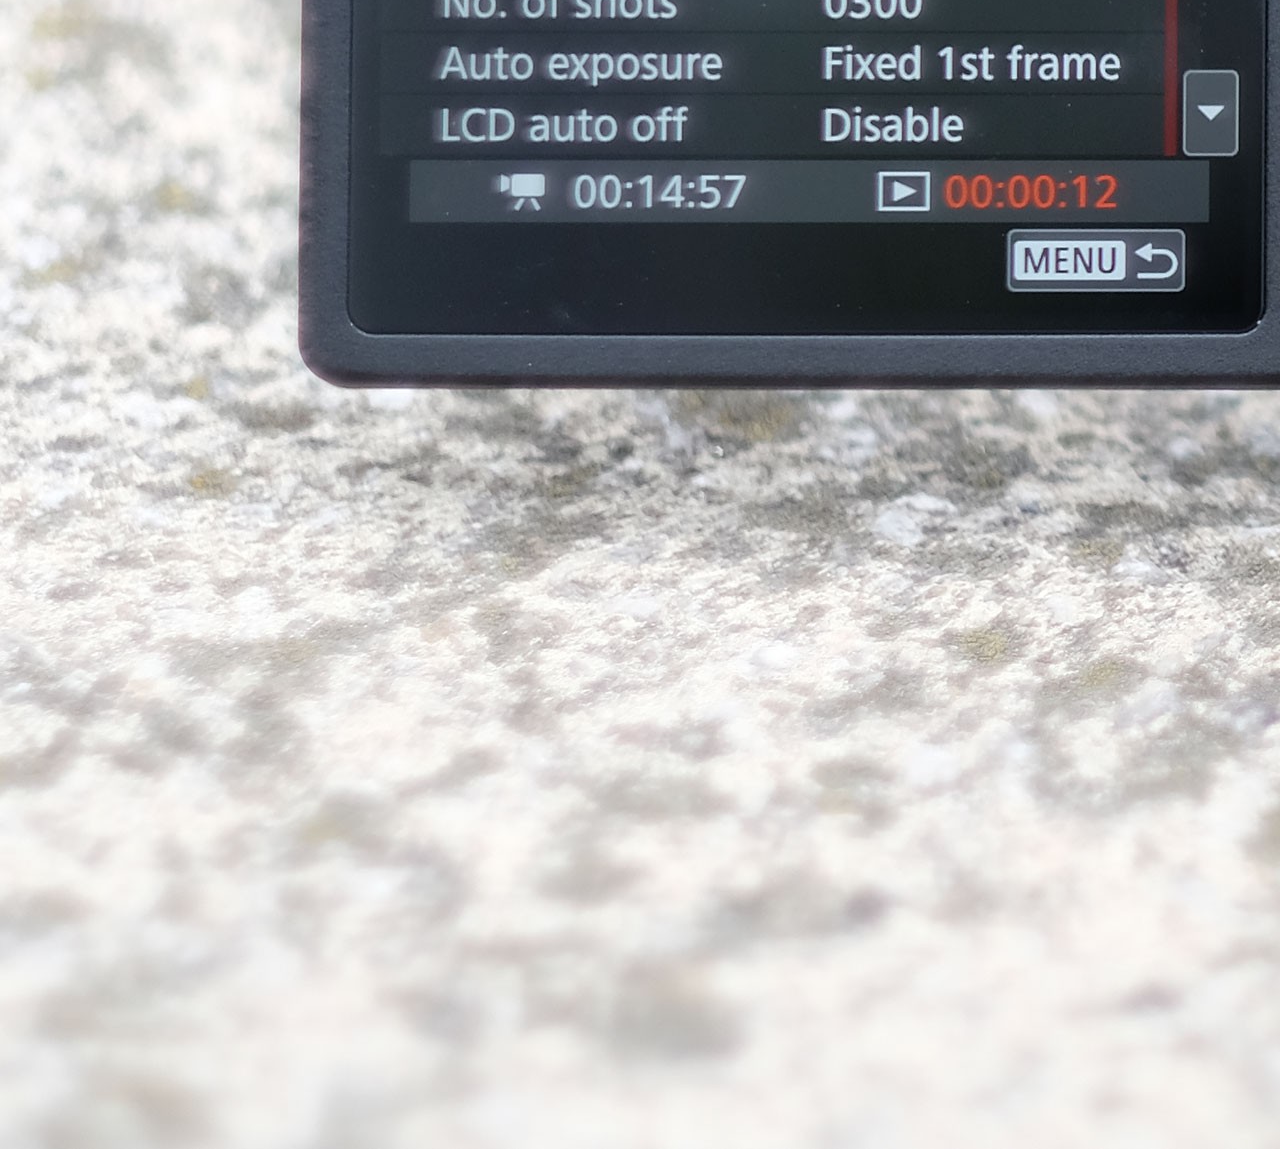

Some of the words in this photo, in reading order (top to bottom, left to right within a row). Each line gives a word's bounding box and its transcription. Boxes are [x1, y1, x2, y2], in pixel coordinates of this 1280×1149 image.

[440, 47, 534, 80] Auto
[548, 51, 723, 87] exposure
[822, 45, 921, 80] Fixed
[938, 46, 995, 81] 1st
[1007, 45, 1121, 80] frame
[441, 107, 516, 142] LCD
[529, 108, 618, 142] auto
[632, 106, 690, 142] off
[822, 106, 965, 142] Disable
[573, 174, 747, 209] 00:14:57
[944, 174, 1119, 210] 00:00:12
[1023, 246, 1117, 274] MENU
